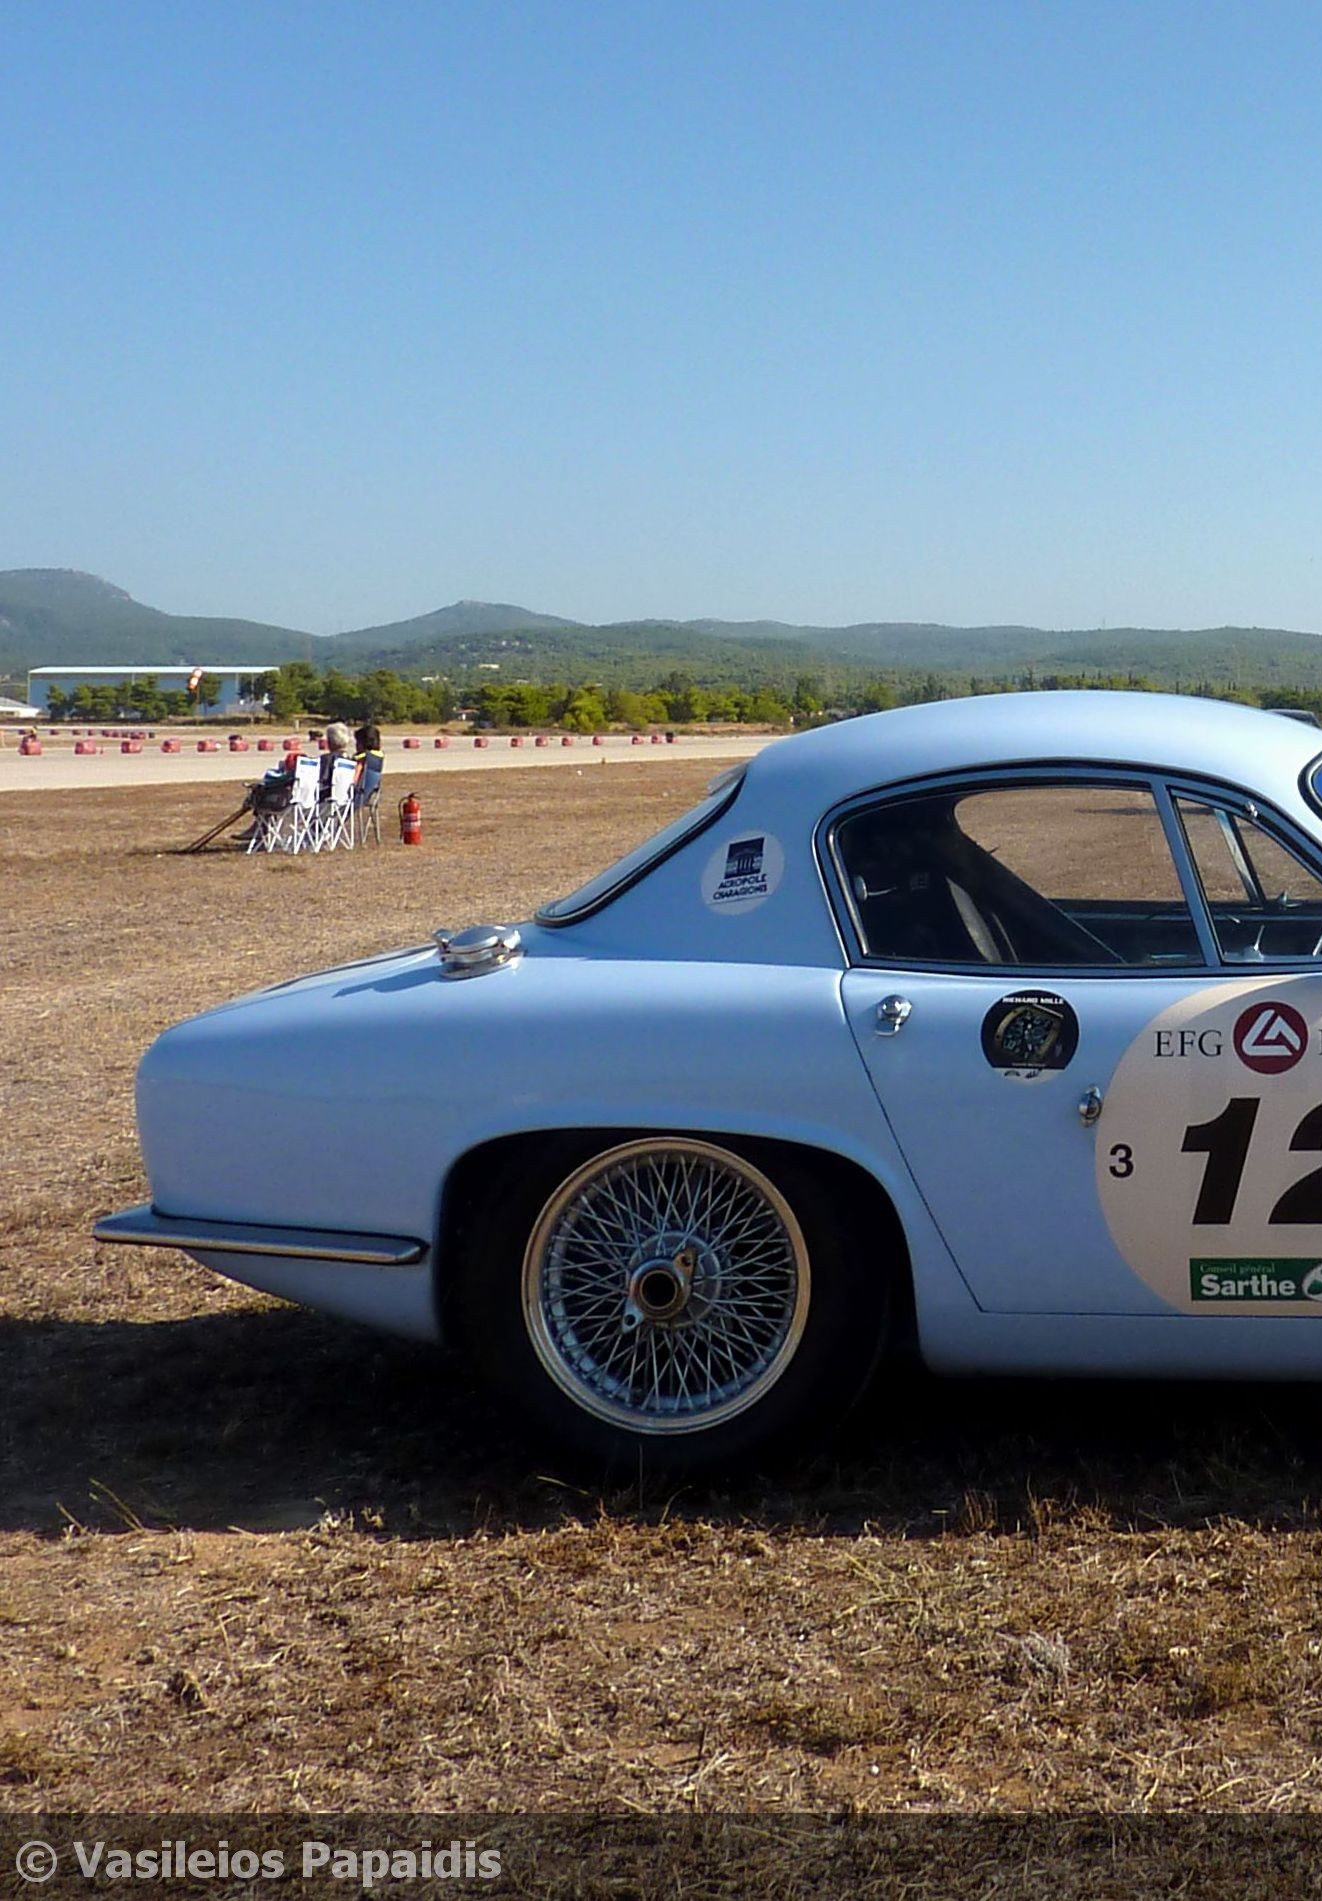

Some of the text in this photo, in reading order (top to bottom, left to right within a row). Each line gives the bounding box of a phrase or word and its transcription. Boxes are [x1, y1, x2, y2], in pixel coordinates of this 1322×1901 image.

[1154, 1030, 1224, 1057] EFG
[1109, 1143, 1134, 1178] 3
[1201, 1274, 1296, 1297] Sarthe
